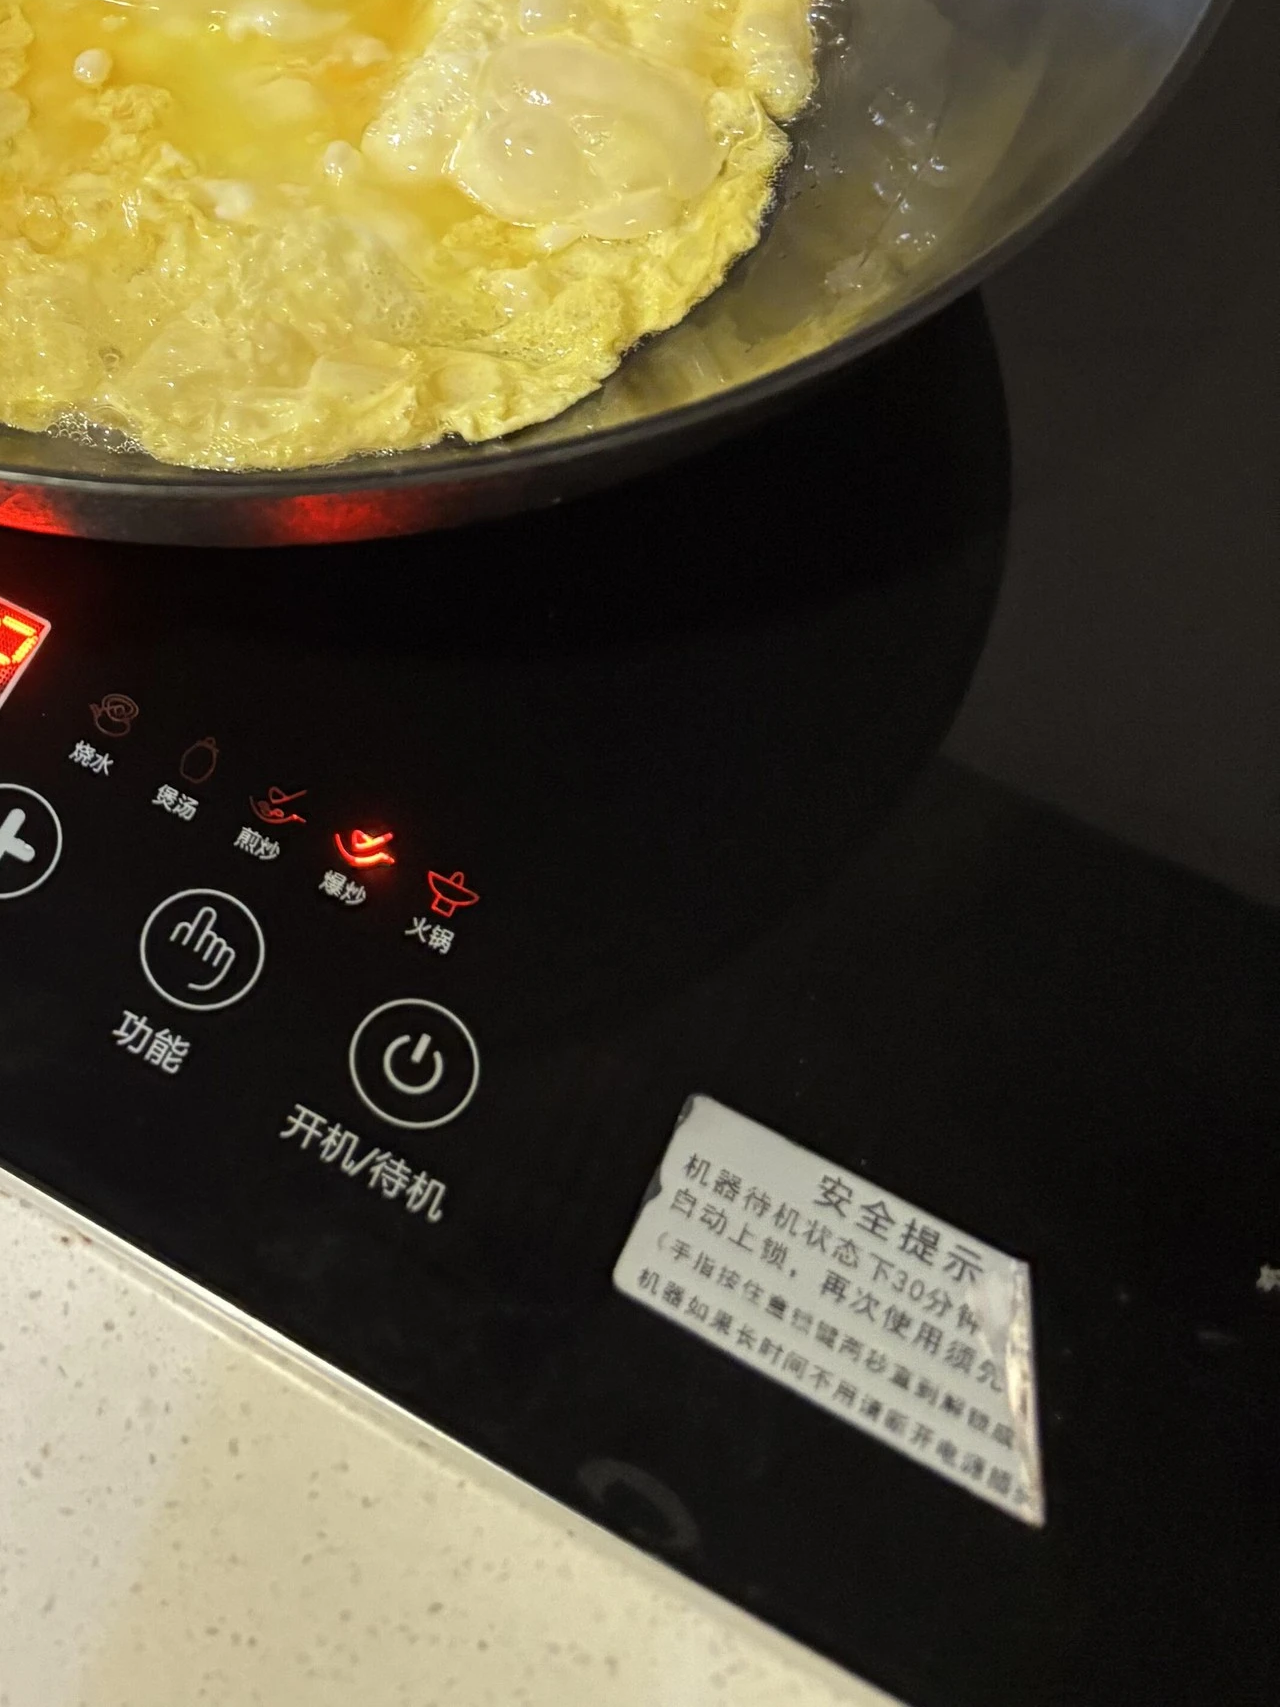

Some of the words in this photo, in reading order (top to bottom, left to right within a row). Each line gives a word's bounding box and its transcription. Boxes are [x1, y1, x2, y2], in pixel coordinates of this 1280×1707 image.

[68, 740, 114, 776] 烧水
[152, 784, 199, 821] 煲汤
[233, 826, 281, 861] 煎炒
[318, 870, 367, 906] 爆炒
[405, 915, 455, 955] 火锅
[112, 1010, 191, 1074] 功能
[279, 1103, 447, 1224] 开机/待机
[812, 1173, 984, 1284] 安全提示
